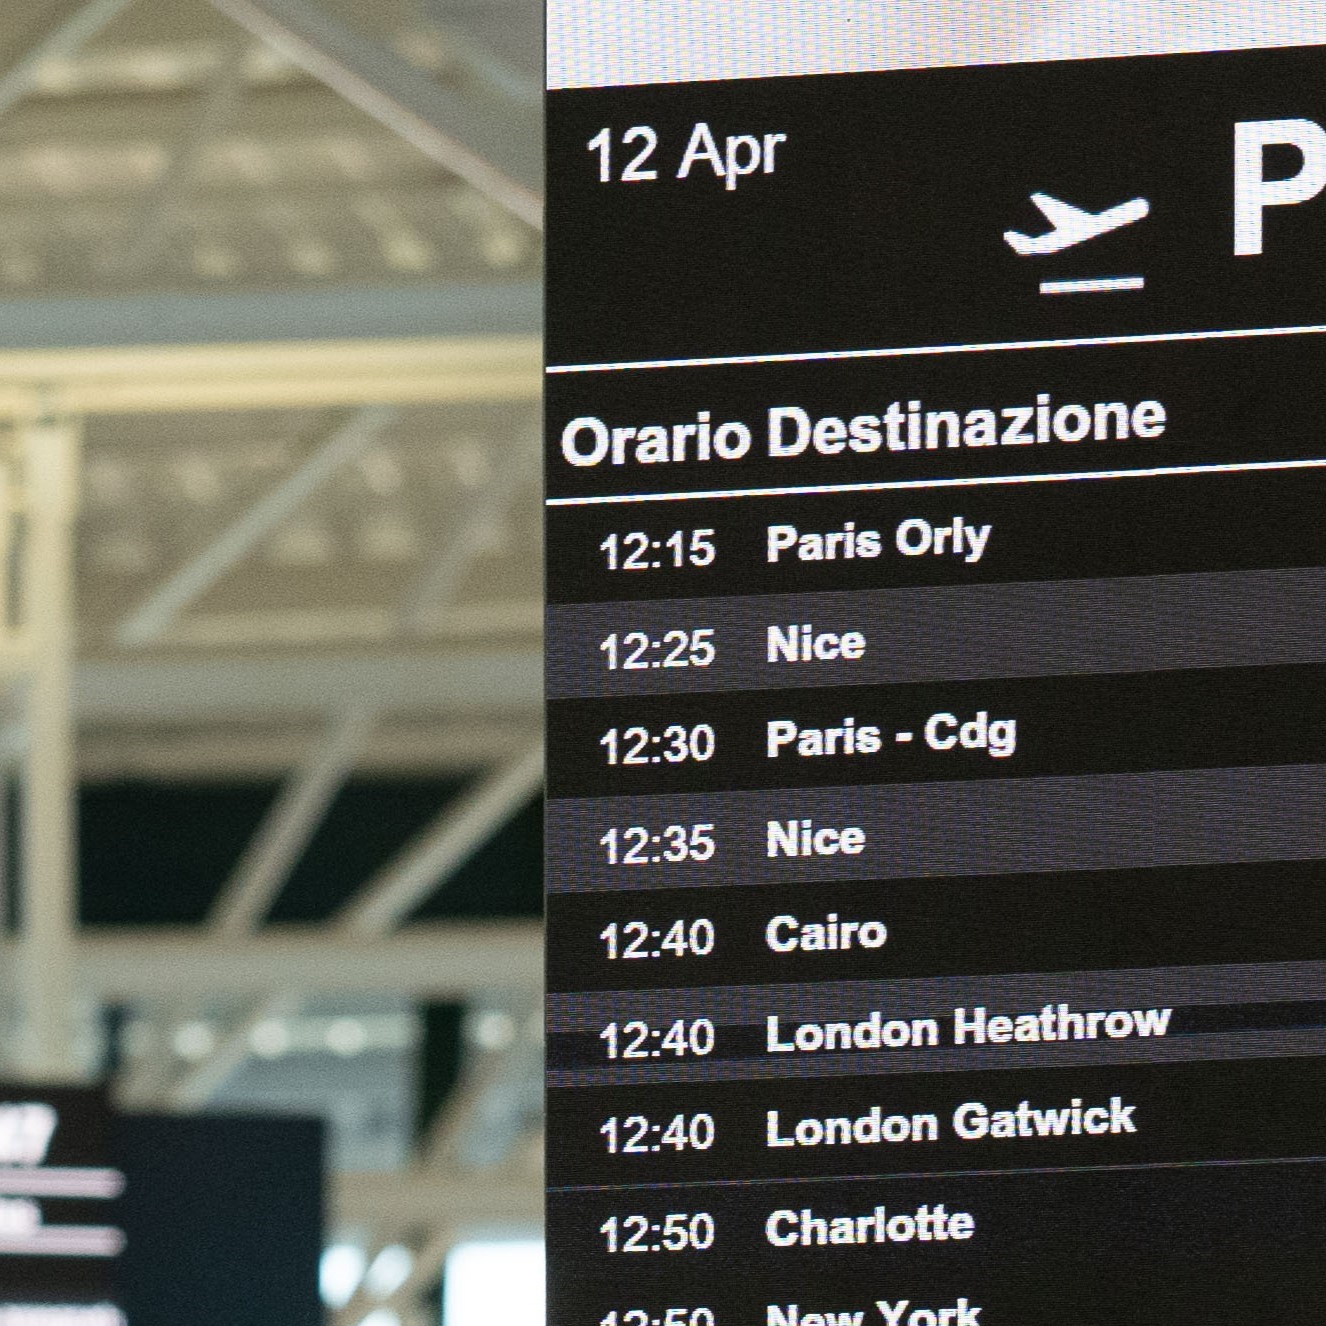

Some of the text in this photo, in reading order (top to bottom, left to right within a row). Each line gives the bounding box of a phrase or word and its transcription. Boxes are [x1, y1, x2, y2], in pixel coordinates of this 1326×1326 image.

[588, 123, 786, 190] 12 Apr
[561, 411, 752, 467] Orario
[768, 394, 1167, 457] Destinazione
[601, 529, 715, 570] 12:15
[768, 517, 991, 562] Paris Orly
[600, 629, 715, 670] 12:25
[767, 624, 866, 662] Nice
[600, 724, 714, 764] 12:30
[768, 717, 881, 757] Paris
[925, 711, 1016, 757] Cdg
[600, 824, 715, 864] 12:35
[767, 819, 866, 857] Nice
[600, 919, 714, 959] 12:40
[766, 913, 887, 952] Cairo
[600, 1019, 714, 1058] 12:40
[767, 1003, 1172, 1052] London Heathrow
[600, 1114, 714, 1153] 12:40
[767, 1097, 1136, 1147] London Gatwick
[600, 1213, 714, 1252] 12:50
[766, 1204, 974, 1246] Charlotte
